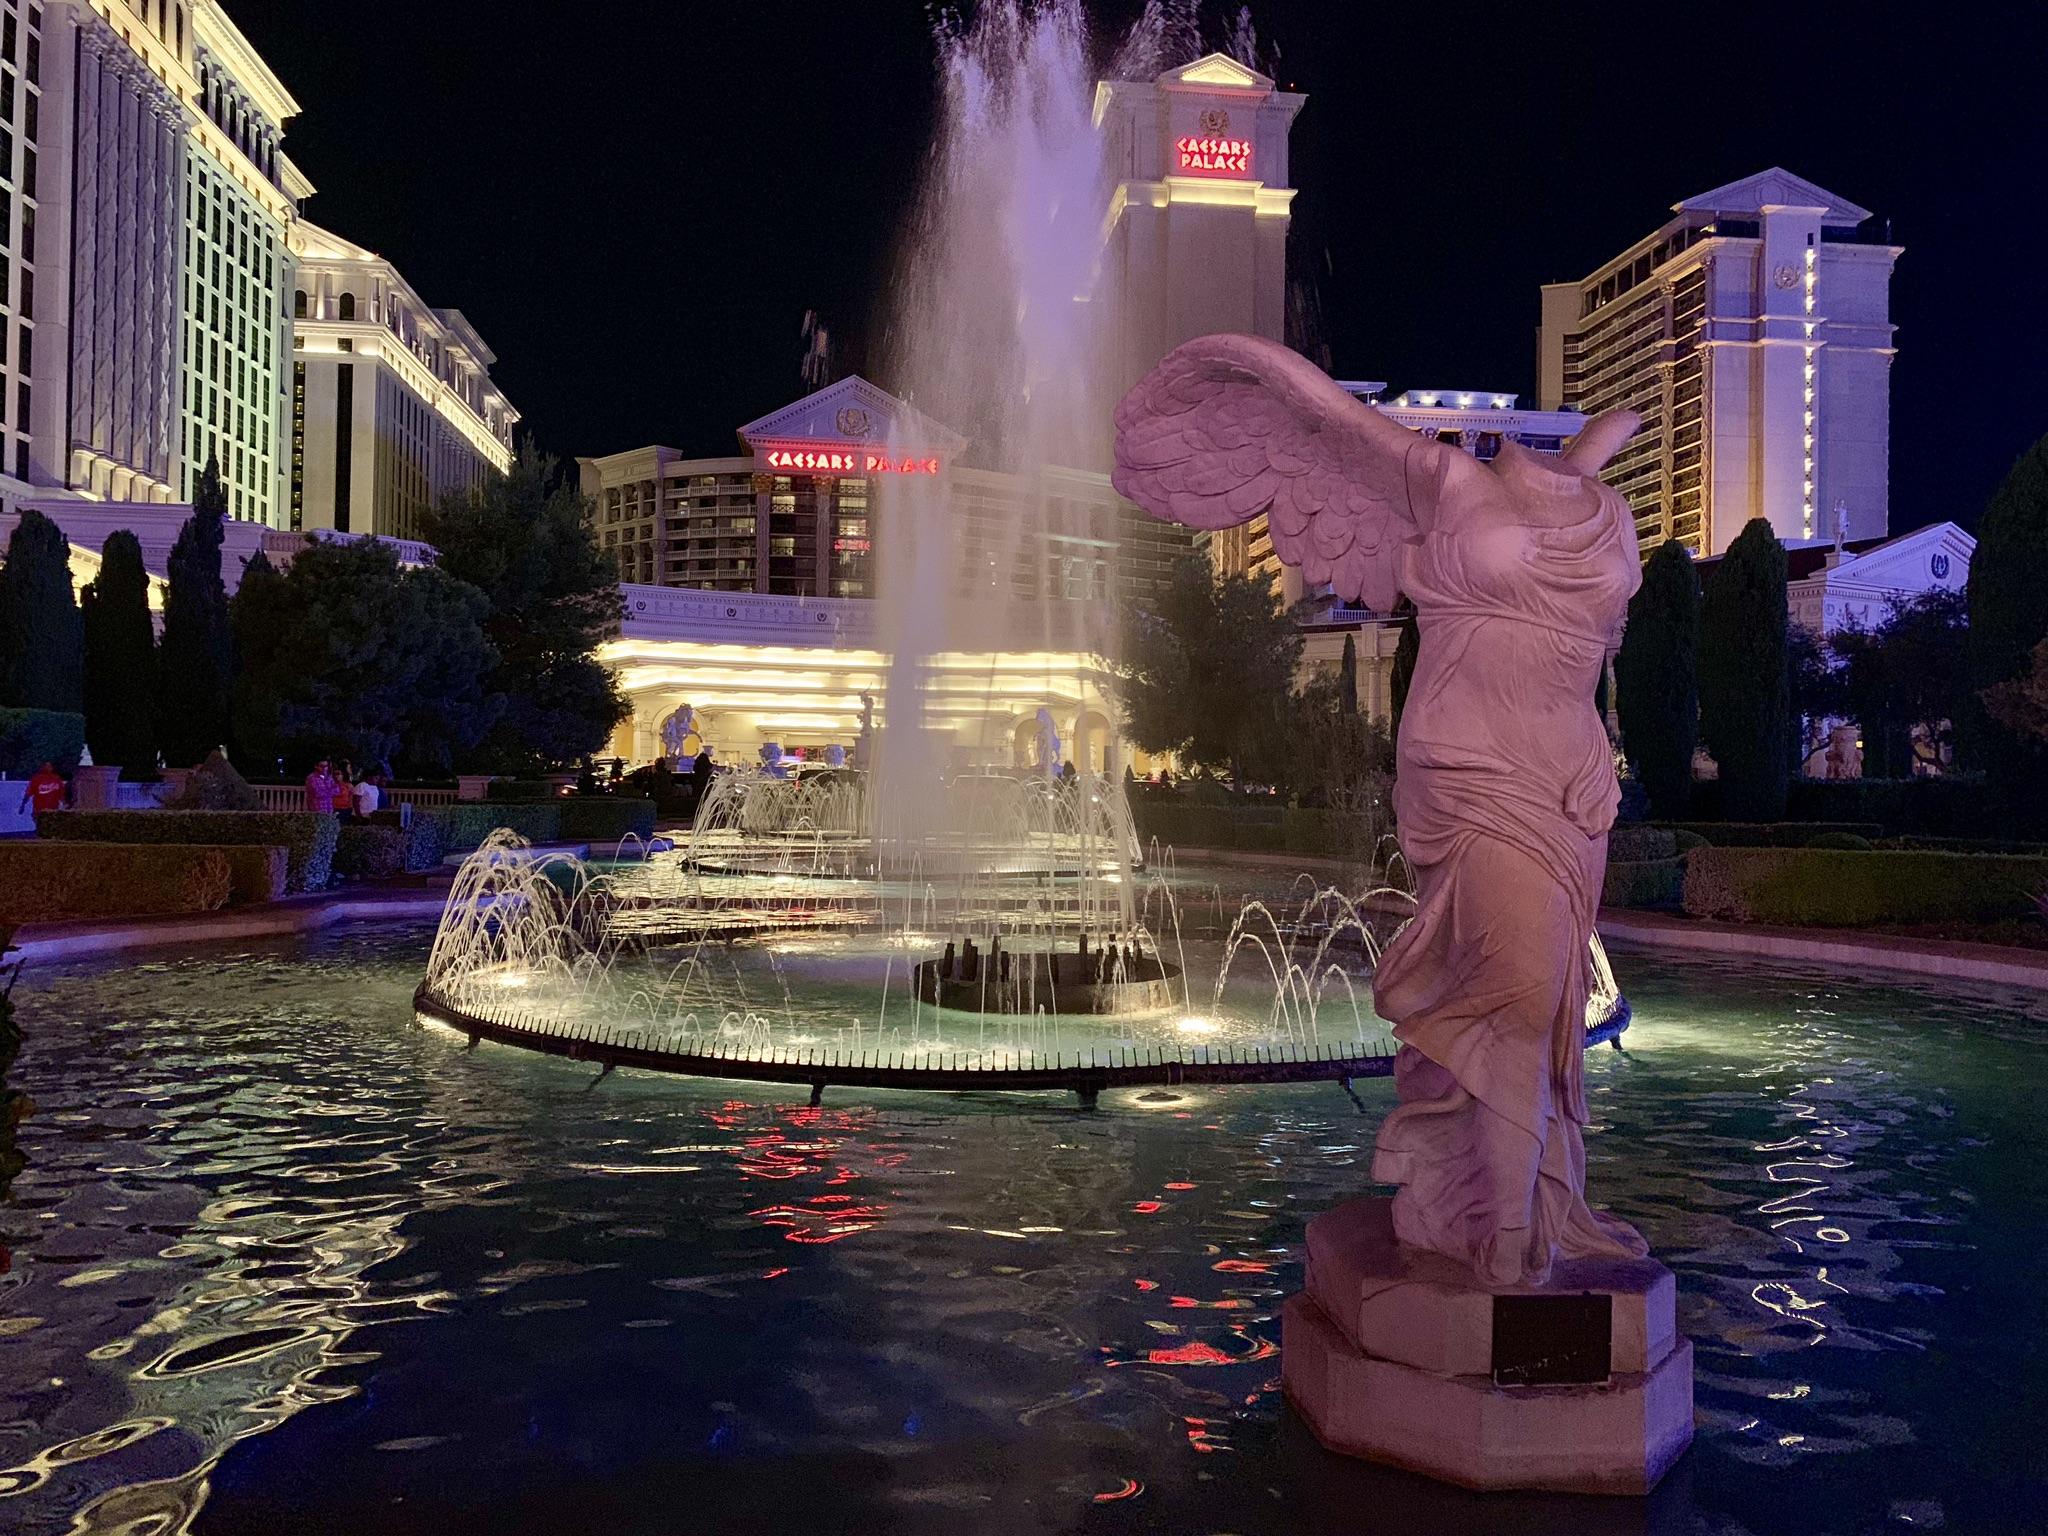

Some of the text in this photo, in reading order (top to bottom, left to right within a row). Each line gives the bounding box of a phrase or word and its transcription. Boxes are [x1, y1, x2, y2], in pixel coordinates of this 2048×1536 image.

[1177, 137, 1251, 156] CAESARS
[1181, 153, 1247, 171] PALACE
[767, 451, 855, 470] CAESARS
